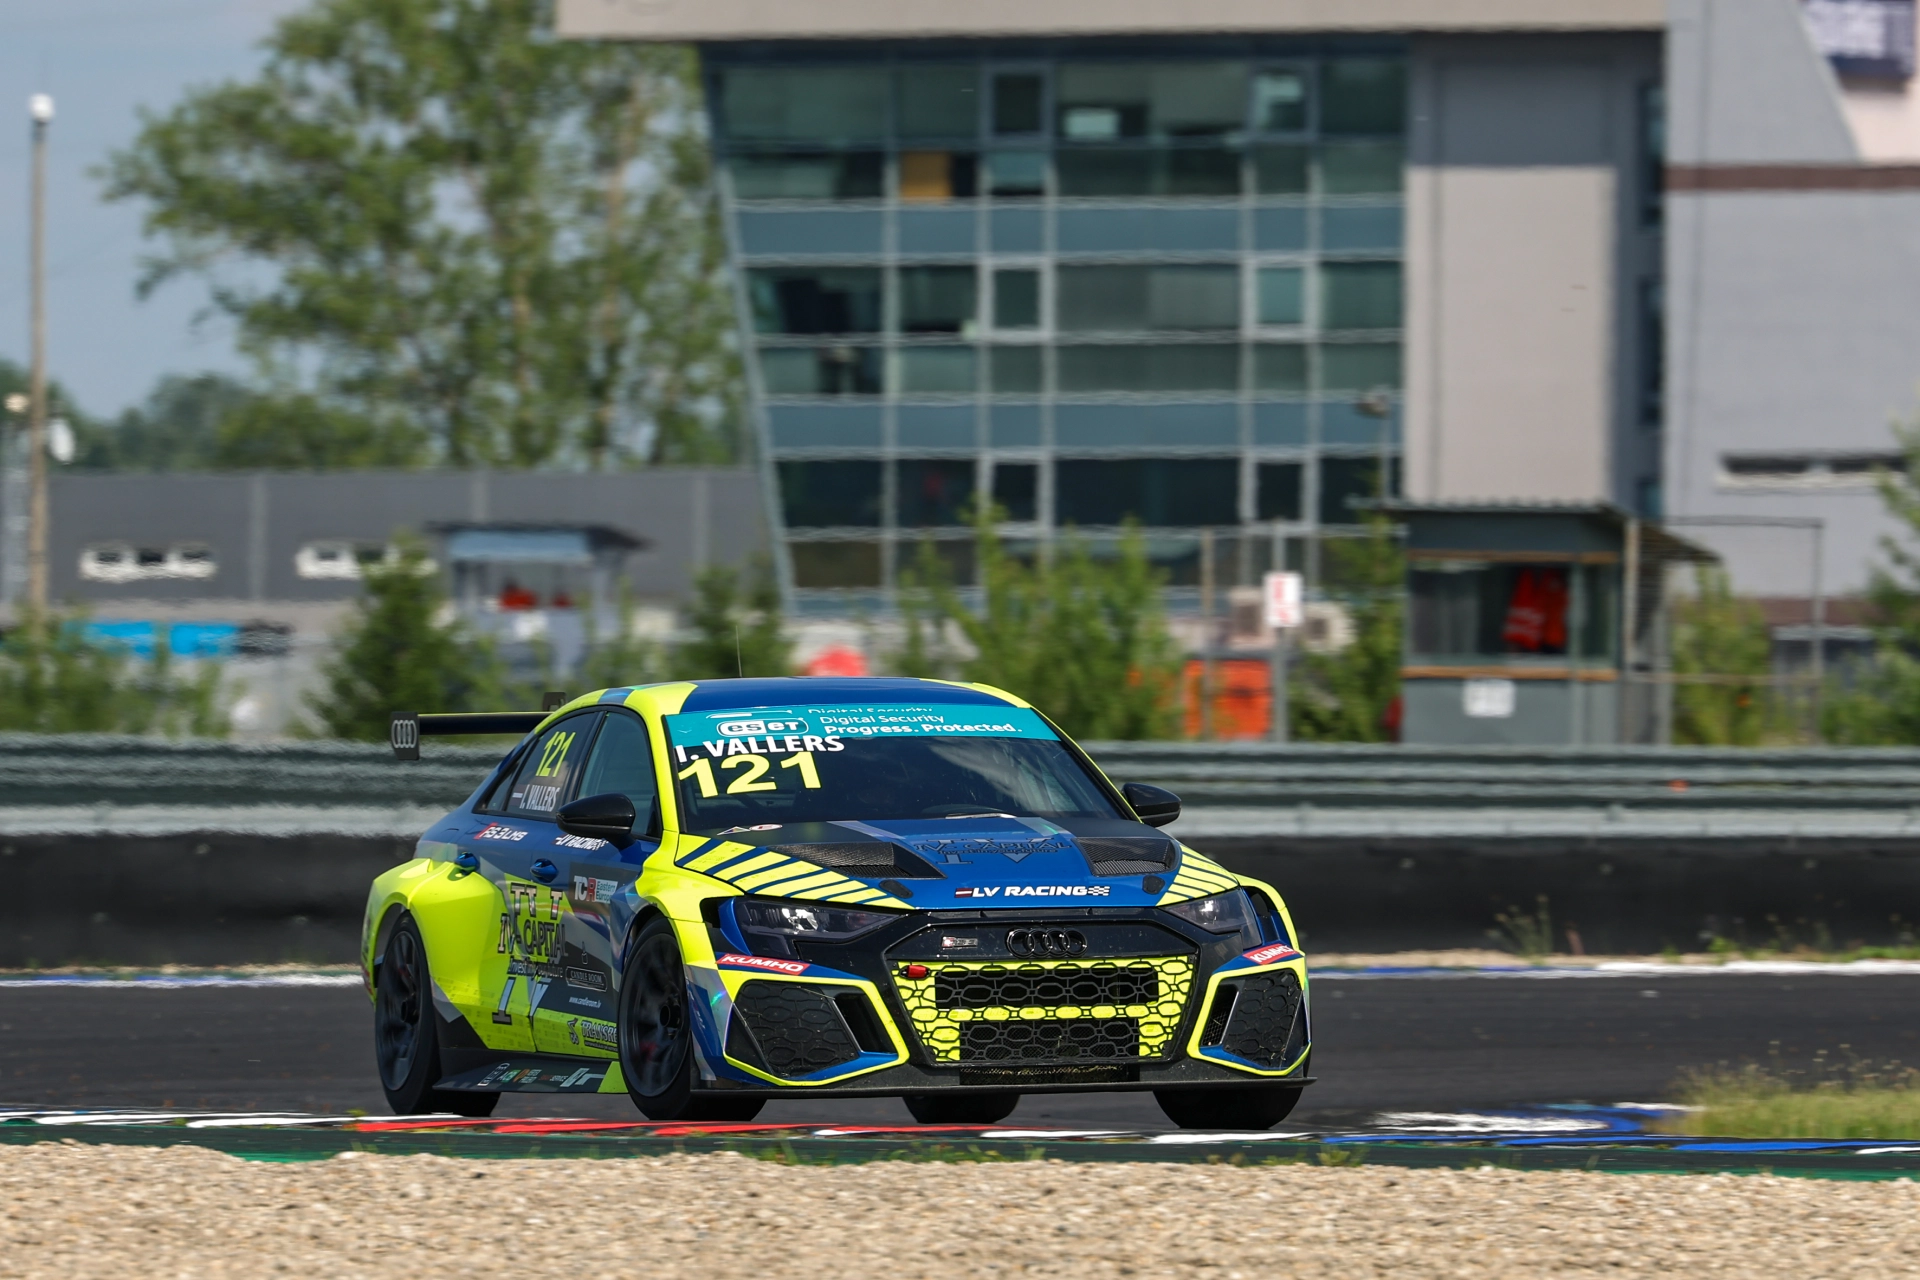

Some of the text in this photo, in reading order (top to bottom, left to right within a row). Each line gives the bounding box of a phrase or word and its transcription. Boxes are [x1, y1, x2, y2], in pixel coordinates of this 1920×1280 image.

[820, 714, 945, 725] Digital Security
[824, 723, 1023, 735] Progress. Protected.
[535, 731, 576, 777] 121
[675, 735, 845, 763] I. VALLERS
[677, 751, 822, 798] 121
[525, 784, 561, 812] VALLERS
[963, 842, 1072, 850] CAPITAL
[573, 875, 597, 902] TCR
[972, 886, 1088, 897] LV RACING
[523, 919, 568, 957] CAPITAL
[722, 956, 804, 972] KUMHO
